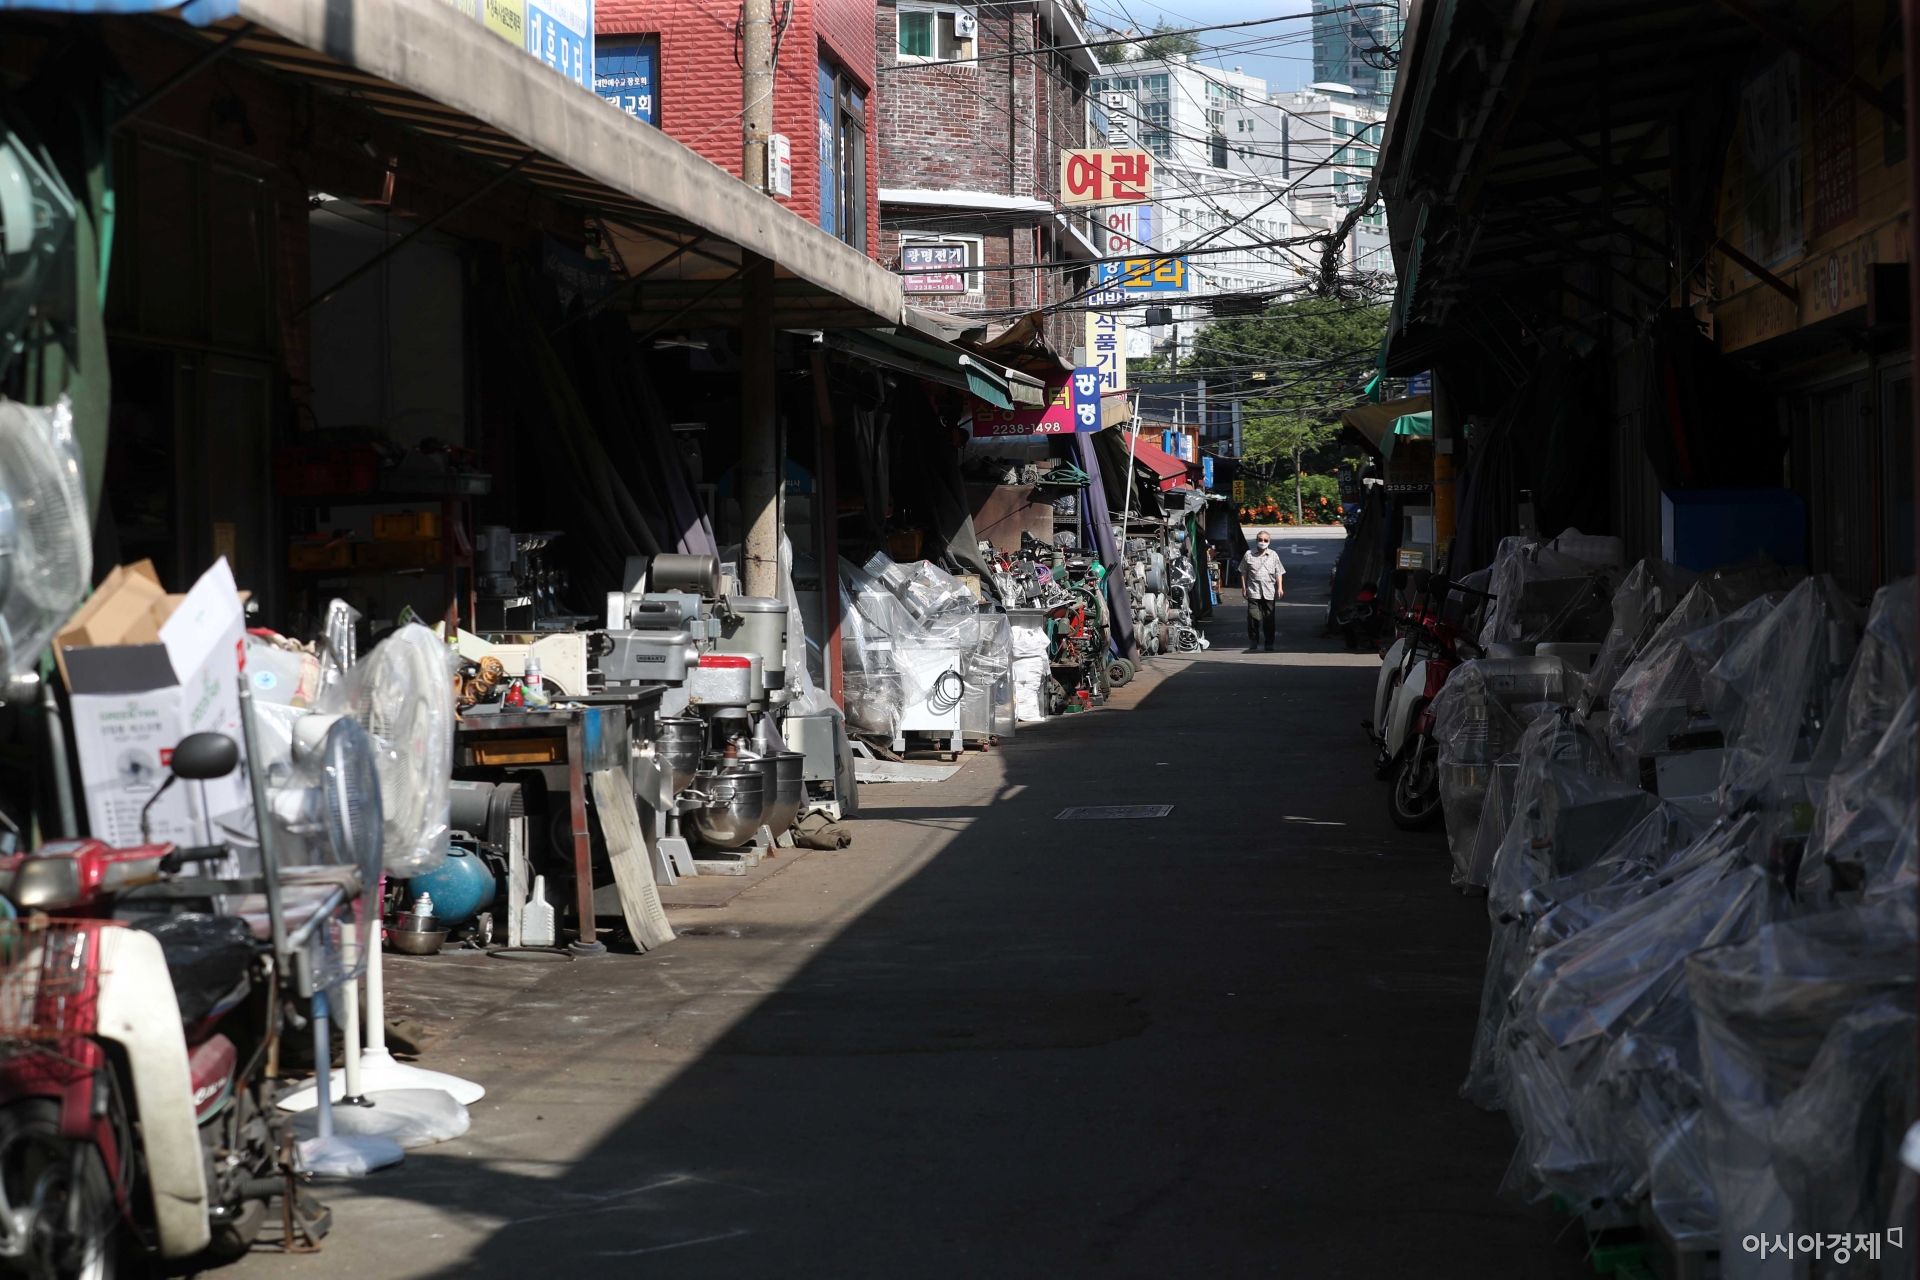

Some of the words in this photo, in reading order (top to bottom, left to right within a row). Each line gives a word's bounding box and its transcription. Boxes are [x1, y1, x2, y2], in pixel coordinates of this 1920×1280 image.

[1066, 154, 1149, 200] 여관
[906, 248, 961, 262] 광명전기
[1123, 258, 1185, 287] 모타
[1094, 314, 1118, 388] 식품기계
[1075, 374, 1097, 425] 광명
[992, 422, 1061, 435] 2238-1498
